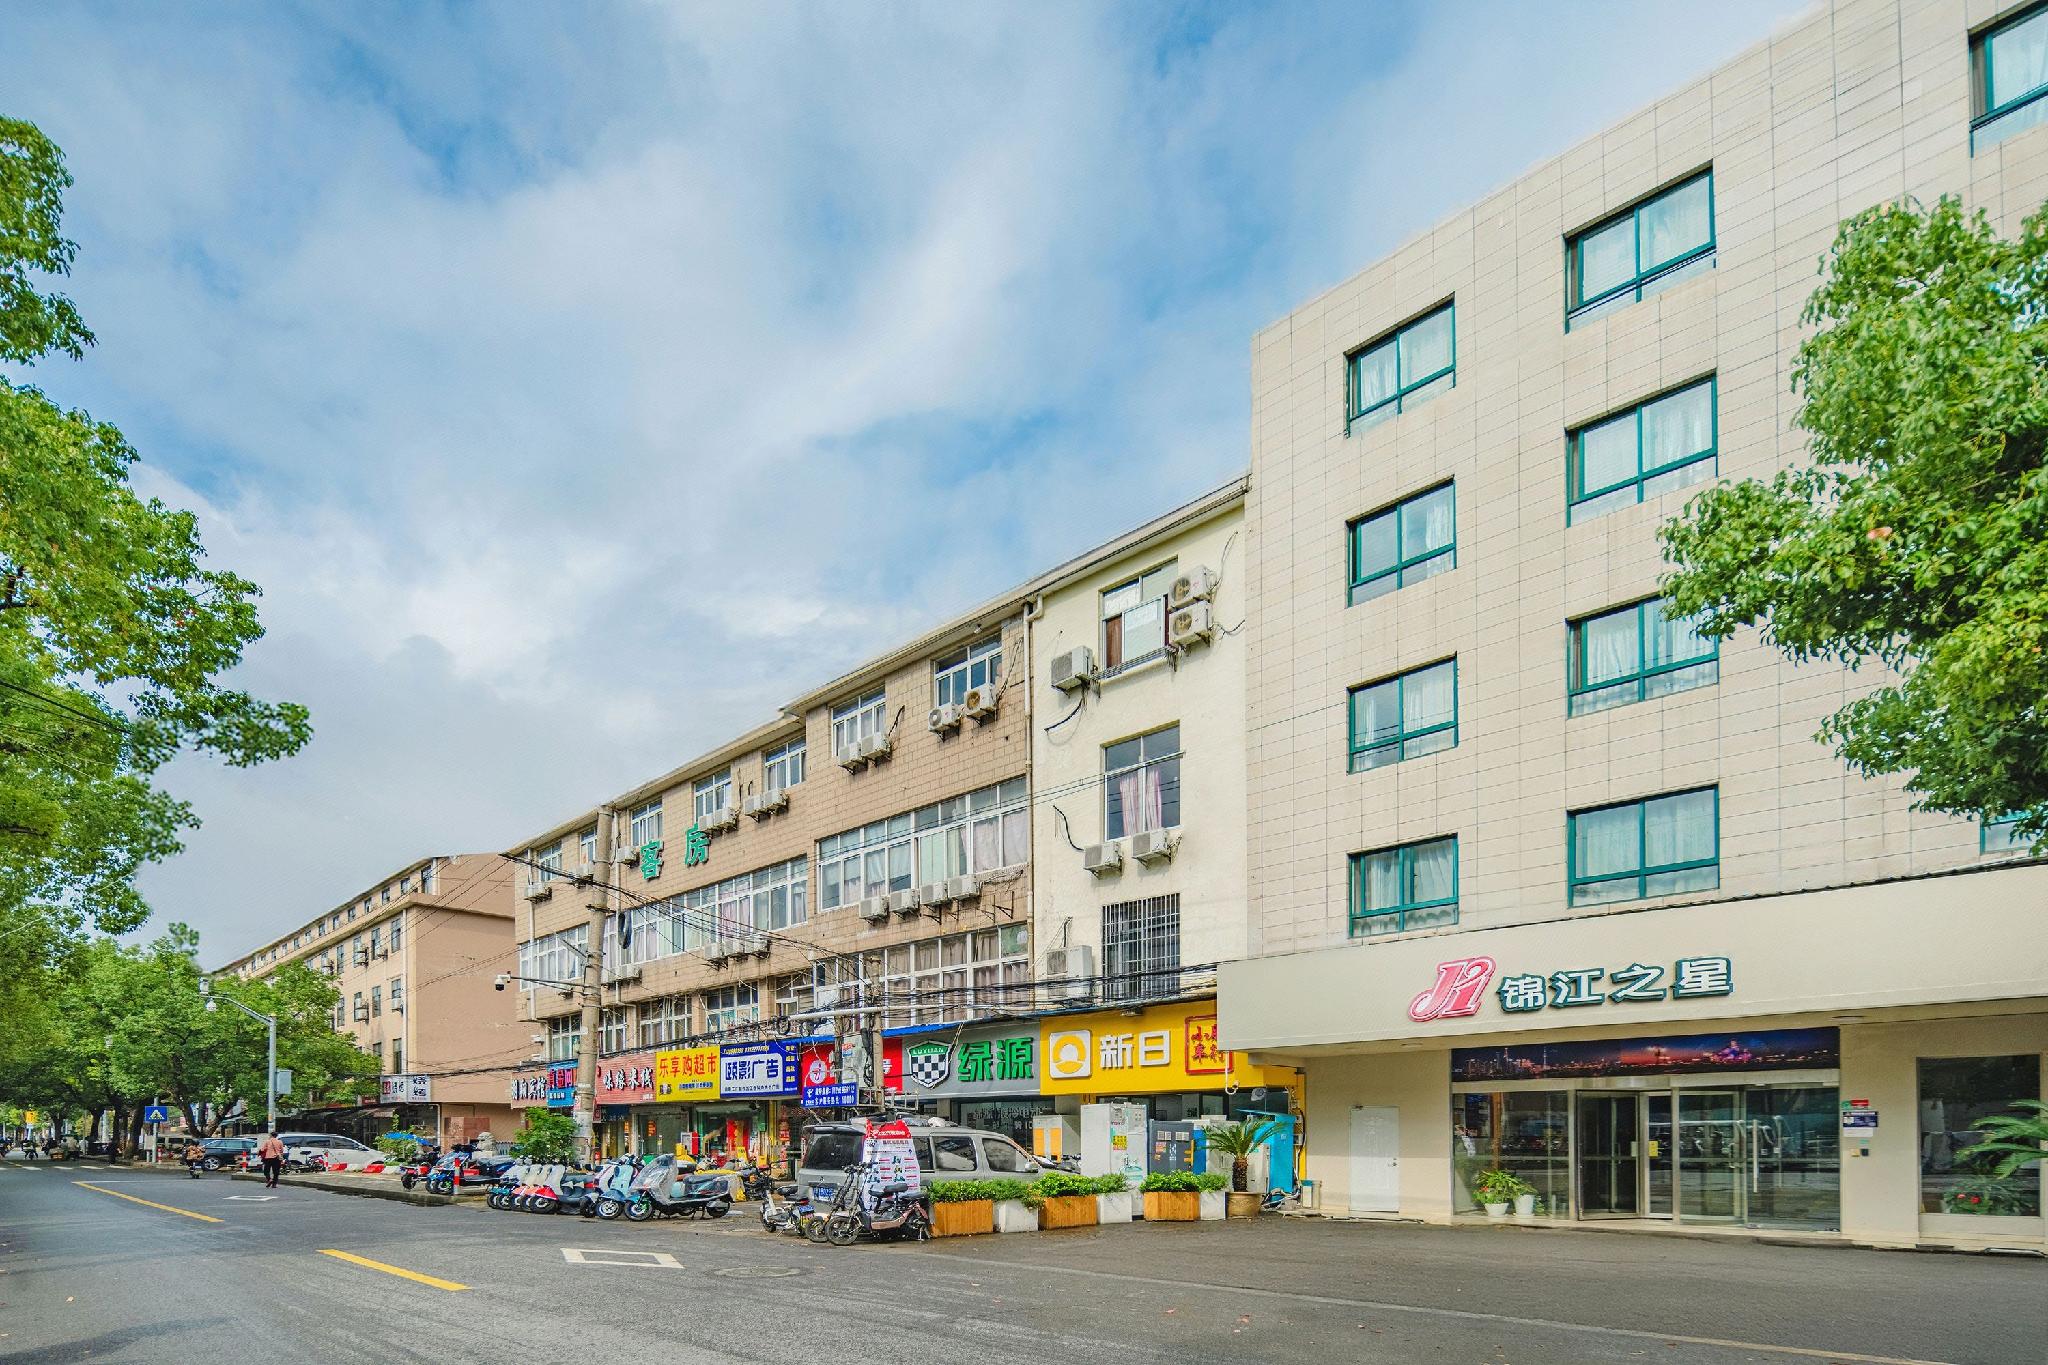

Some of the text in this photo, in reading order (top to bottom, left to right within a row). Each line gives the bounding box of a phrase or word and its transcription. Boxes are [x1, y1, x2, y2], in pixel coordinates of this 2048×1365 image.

[640, 824, 709, 880] 客房
[1497, 957, 1733, 1012] 锦江之星
[659, 1052, 718, 1078] 乐享购超市
[912, 1047, 944, 1055] LUYUAN
[957, 1037, 1034, 1082] 绿源
[1100, 1030, 1170, 1069] 新日
[725, 1059, 779, 1081] 颐影广告
